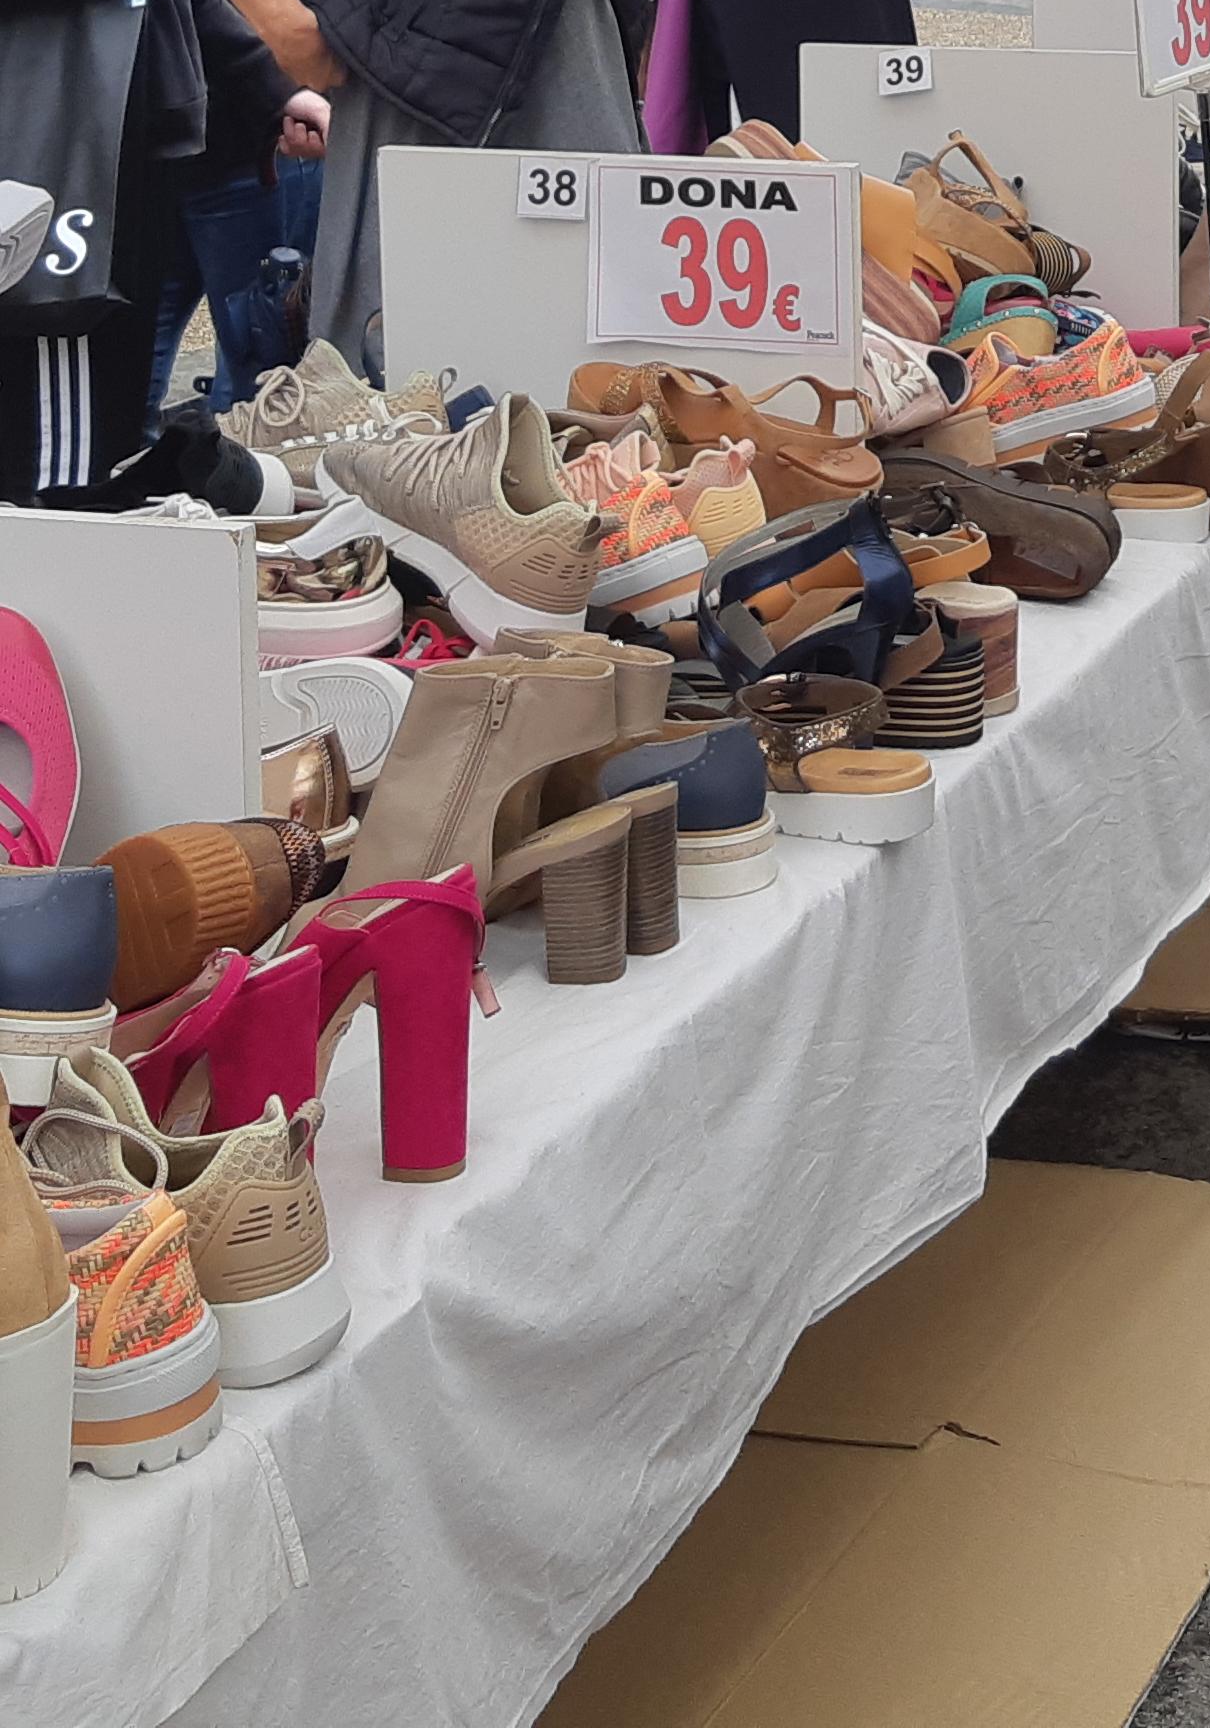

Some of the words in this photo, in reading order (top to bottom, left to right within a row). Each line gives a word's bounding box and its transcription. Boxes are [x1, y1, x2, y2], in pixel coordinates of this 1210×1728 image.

[885, 54, 924, 86] 39
[527, 167, 577, 206] 38
[639, 175, 799, 212] DONA
[660, 215, 802, 332] 39€
